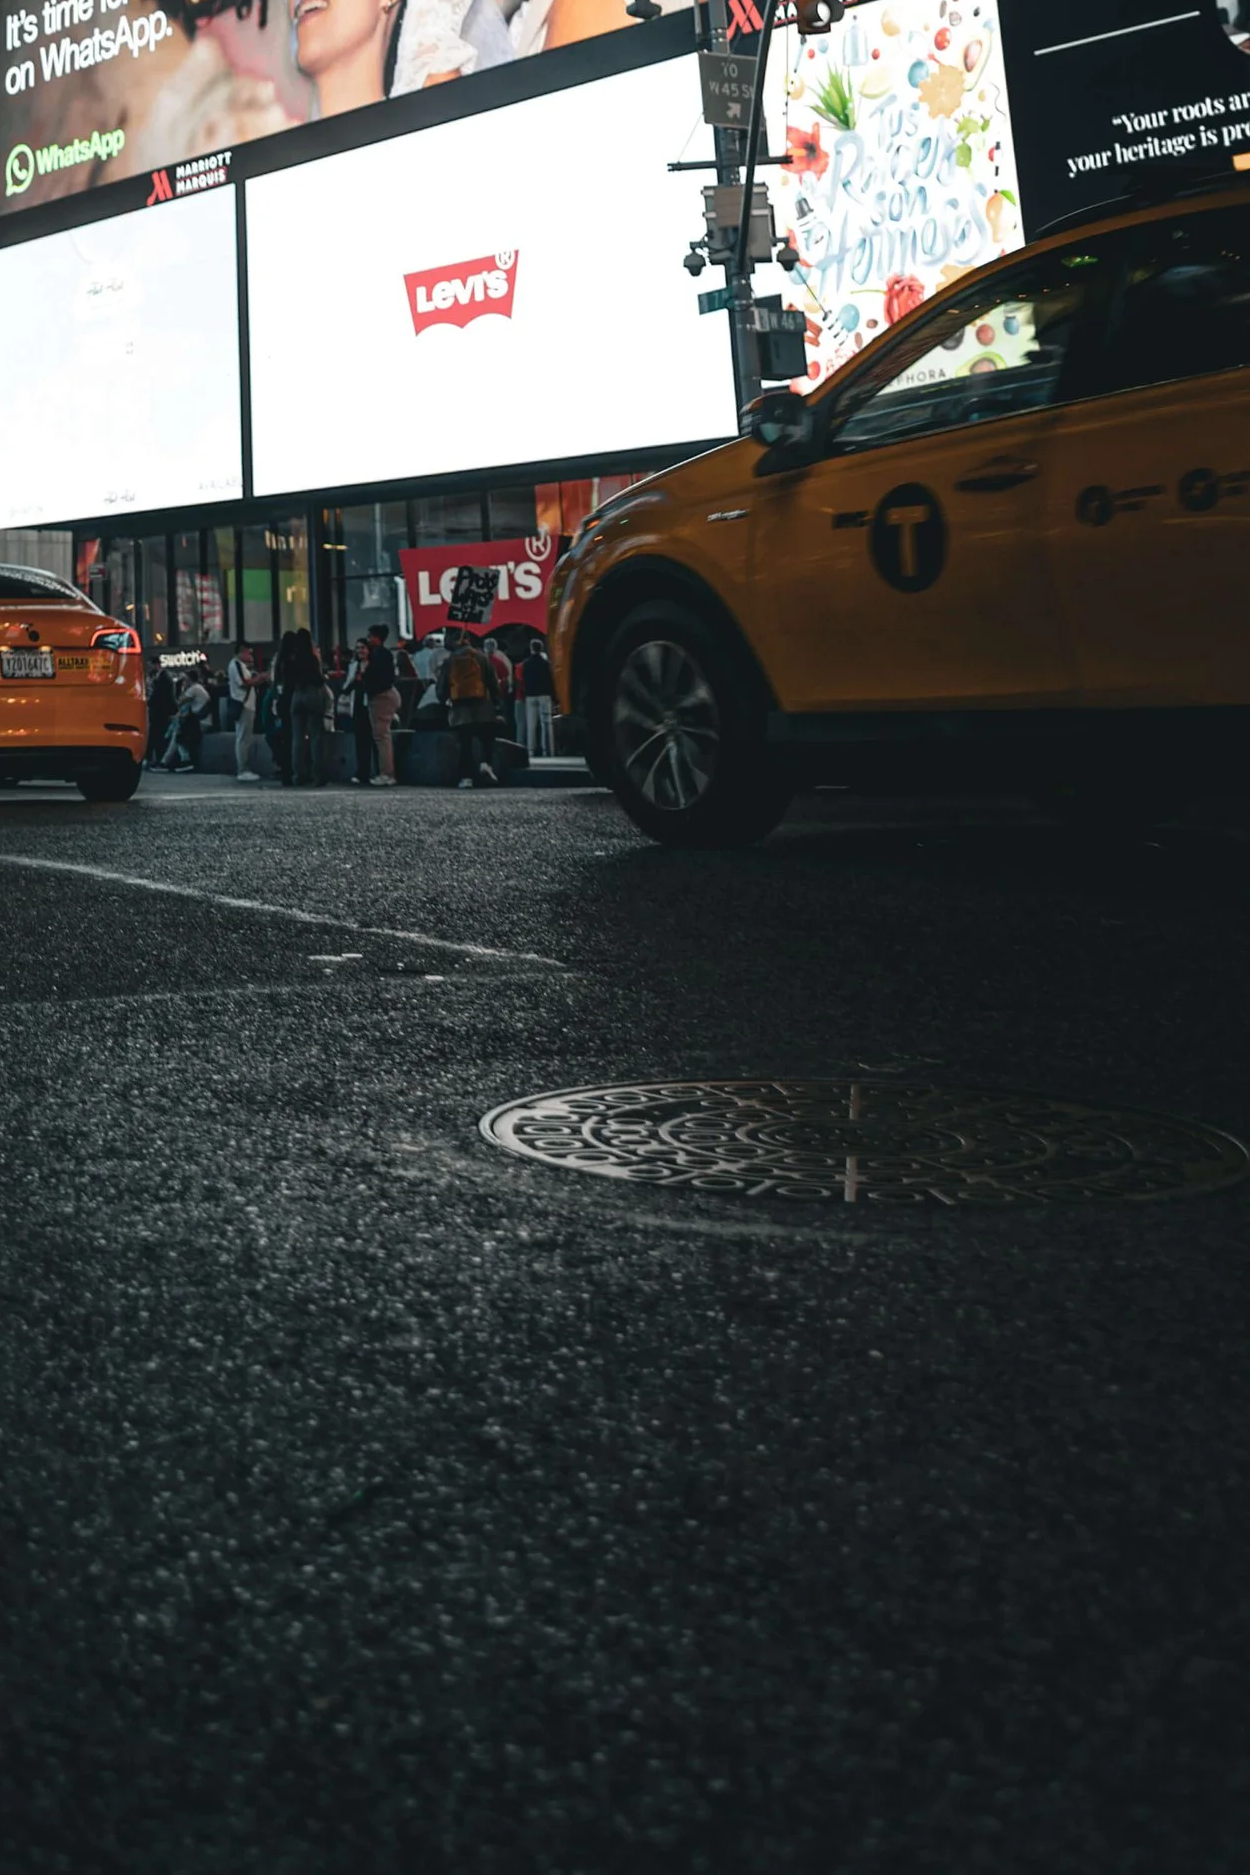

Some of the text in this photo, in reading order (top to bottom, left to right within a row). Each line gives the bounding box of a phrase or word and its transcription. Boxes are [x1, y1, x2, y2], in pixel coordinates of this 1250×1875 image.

[6, 11, 38, 52] It's
[5, 9, 174, 97] on WhatsApp.
[720, 61, 738, 78] TO
[1171, 96, 1226, 124] roots
[35, 128, 125, 176] WhatsApp
[175, 151, 232, 180] MARRIOTT
[1067, 149, 1112, 179] your
[1114, 132, 1196, 164] heritage
[1198, 125, 1219, 147] is
[176, 167, 227, 193] MARQUIS
[869, 183, 930, 227] son
[159, 649, 201, 668] swatch
